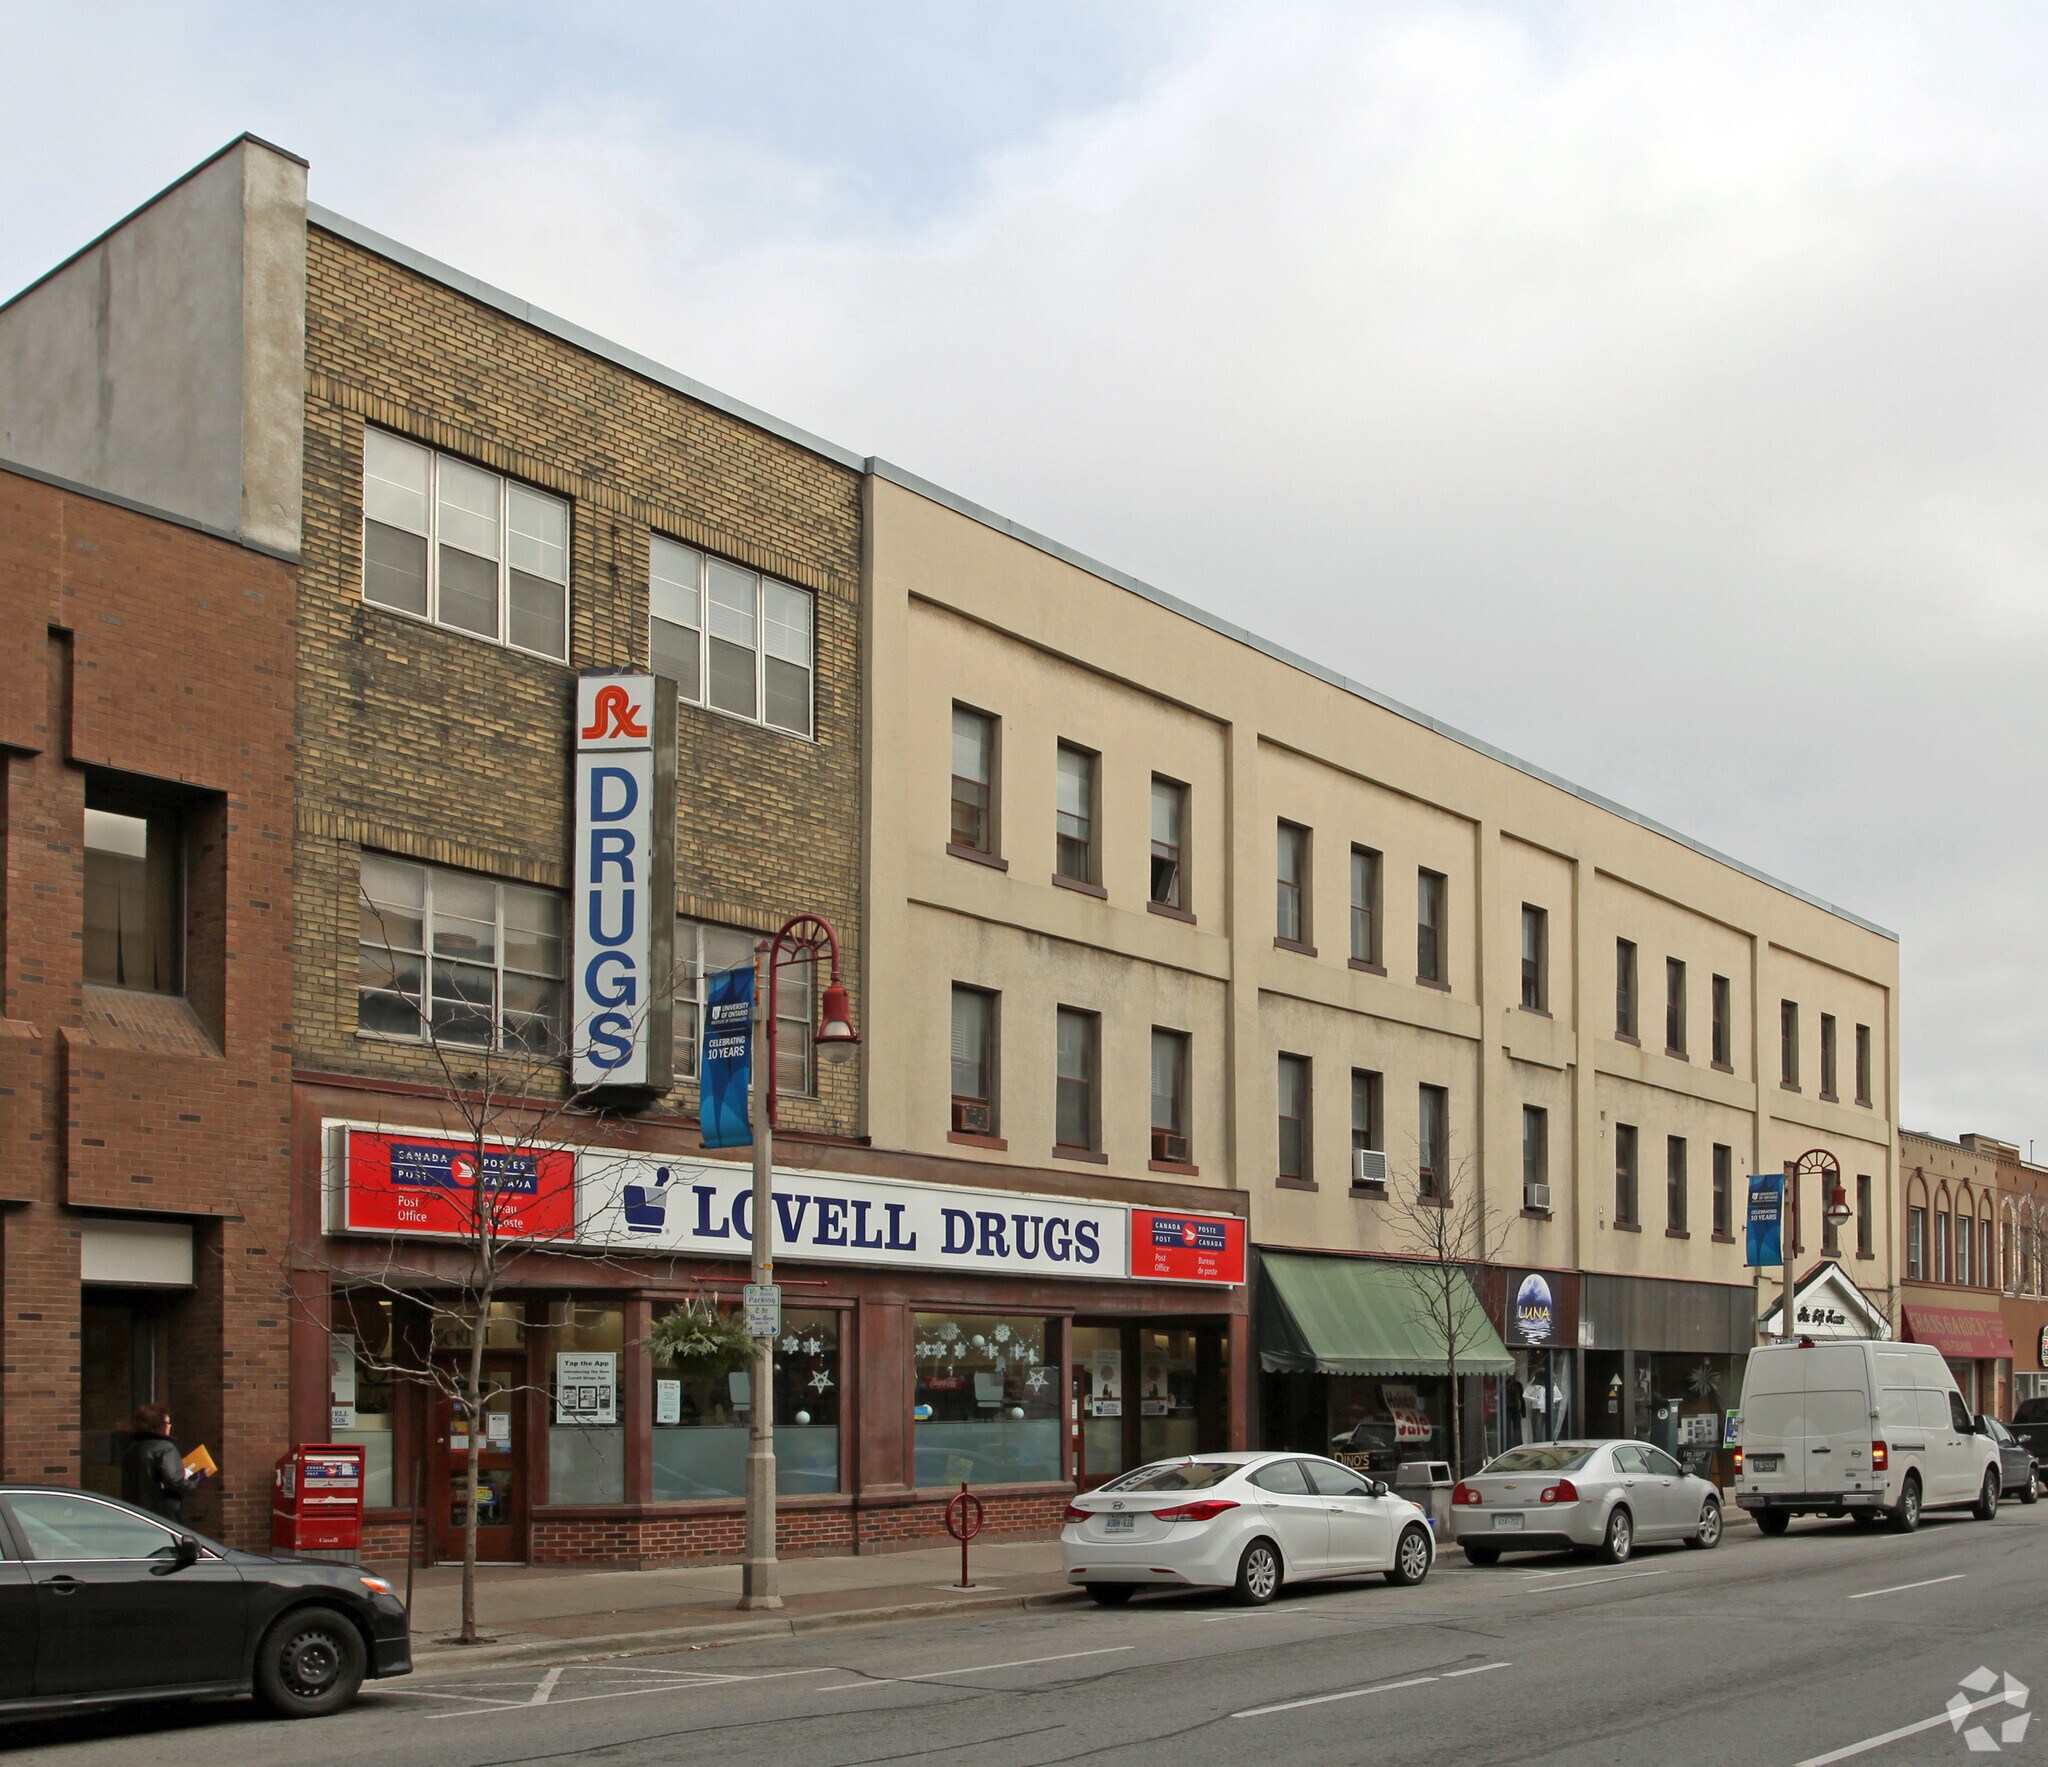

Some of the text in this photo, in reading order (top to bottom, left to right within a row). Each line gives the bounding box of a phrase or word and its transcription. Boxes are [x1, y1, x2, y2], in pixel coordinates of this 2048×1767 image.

[584, 767, 639, 1069] DRUGS
[722, 1002, 749, 1012] UNIVERSITY
[720, 1009, 749, 1019] OF ONTARIO
[709, 1036, 746, 1048] CELEBRATING
[708, 1046, 745, 1060] 10 YEARS
[398, 1150, 449, 1163] CANADA
[398, 1169, 428, 1181] POST
[398, 1195, 420, 1207] Post
[397, 1210, 428, 1223] Office
[1155, 1221, 1181, 1231] CANADA
[1198, 1226, 1216, 1234] POSTE
[940, 1208, 1101, 1265] DRUGS
[1155, 1235, 1171, 1243] POST
[1198, 1239, 1223, 1248] CANADA
[1155, 1253, 1166, 1262] Post
[1198, 1256, 1215, 1266] Bureau
[1154, 1263, 1170, 1273] Office
[1197, 1266, 1218, 1277] de poste
[748, 1296, 776, 1305] Parking
[1518, 1305, 1550, 1321] LUNA
[1394, 1410, 1430, 1436] Sale
